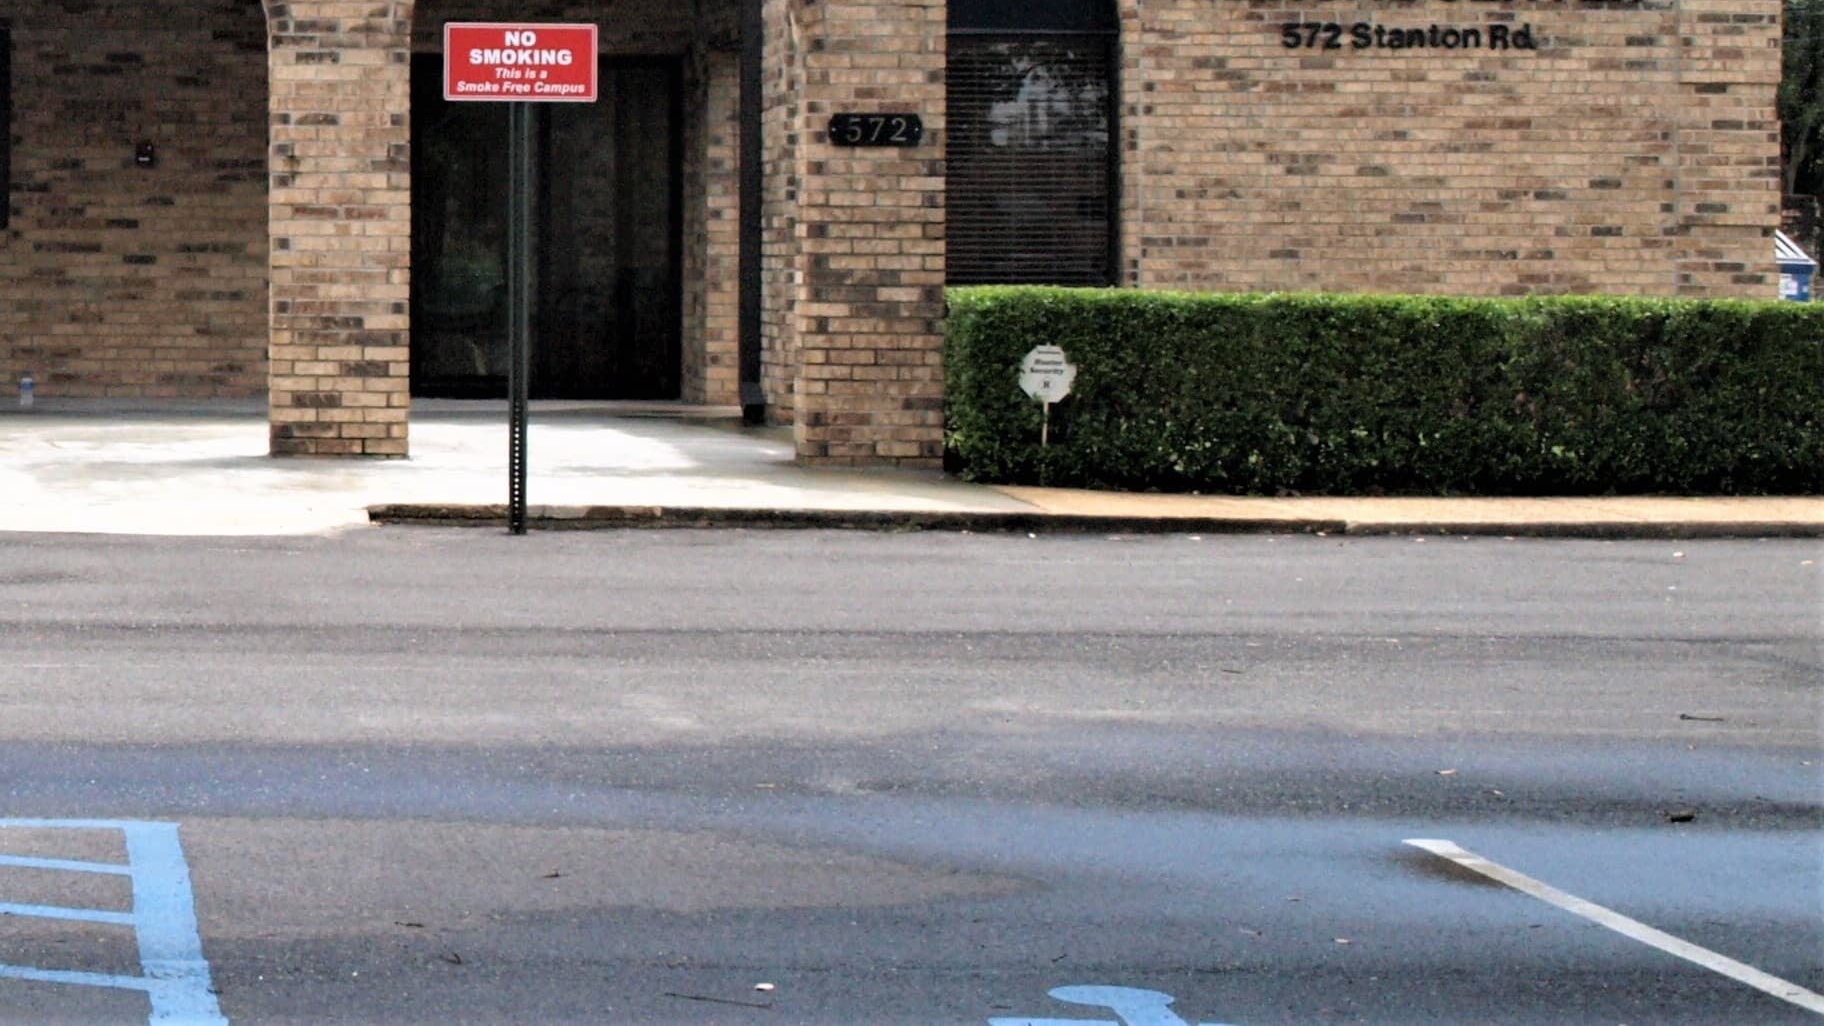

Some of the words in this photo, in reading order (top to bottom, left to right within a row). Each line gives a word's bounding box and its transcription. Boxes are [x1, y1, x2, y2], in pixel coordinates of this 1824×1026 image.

[504, 31, 537, 46] NO
[1282, 22, 1342, 49] 572
[1350, 23, 1482, 49] Stanton
[469, 49, 573, 65] SMOKING
[494, 68, 521, 79] This
[525, 68, 536, 79] is
[539, 70, 548, 79] a
[456, 81, 499, 93] Smoke
[502, 81, 530, 93] Free
[534, 81, 585, 95] Campus
[846, 117, 907, 142] 572
